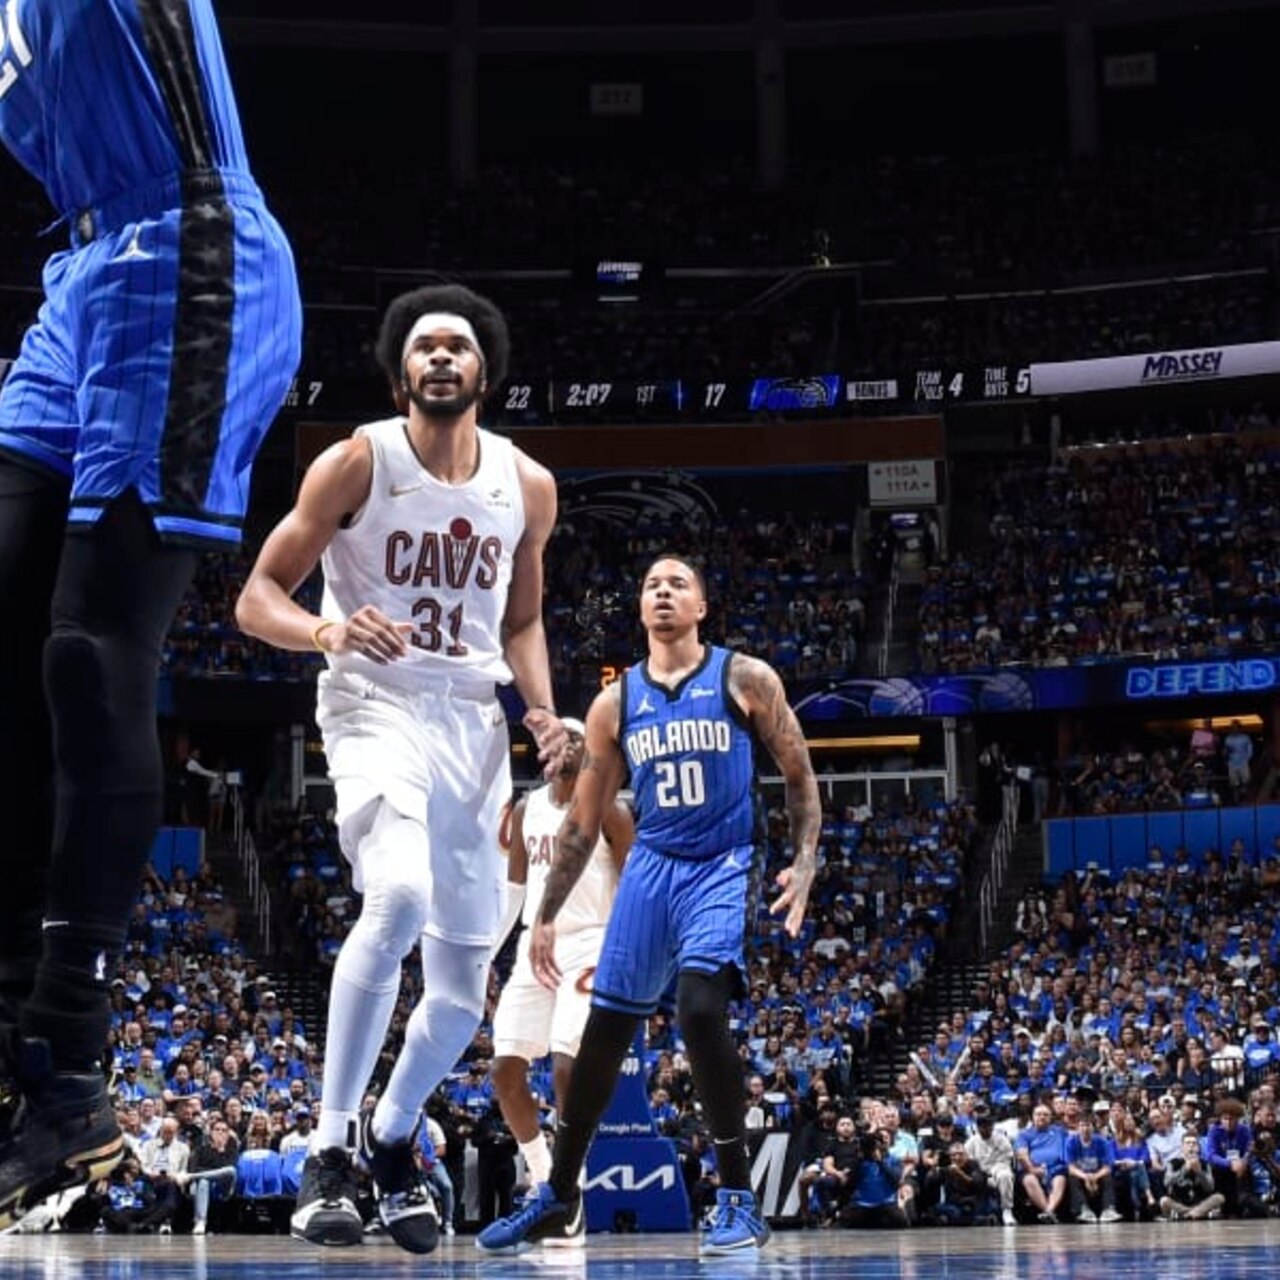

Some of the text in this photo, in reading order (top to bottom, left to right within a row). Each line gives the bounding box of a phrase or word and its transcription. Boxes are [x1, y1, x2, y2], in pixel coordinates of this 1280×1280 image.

[1142, 352, 1222, 378] MASSEY
[307, 381, 323, 406] 7
[704, 383, 726, 408] 17
[948, 372, 964, 398] 4
[1015, 369, 1030, 394] 5
[505, 385, 530, 410] 22
[385, 530, 502, 590] CAVS
[411, 597, 468, 656] 31
[1126, 658, 1276, 698] DEFEND
[627, 720, 731, 766] ORLANDO
[655, 761, 705, 808] 20
[526, 835, 561, 866] CA
